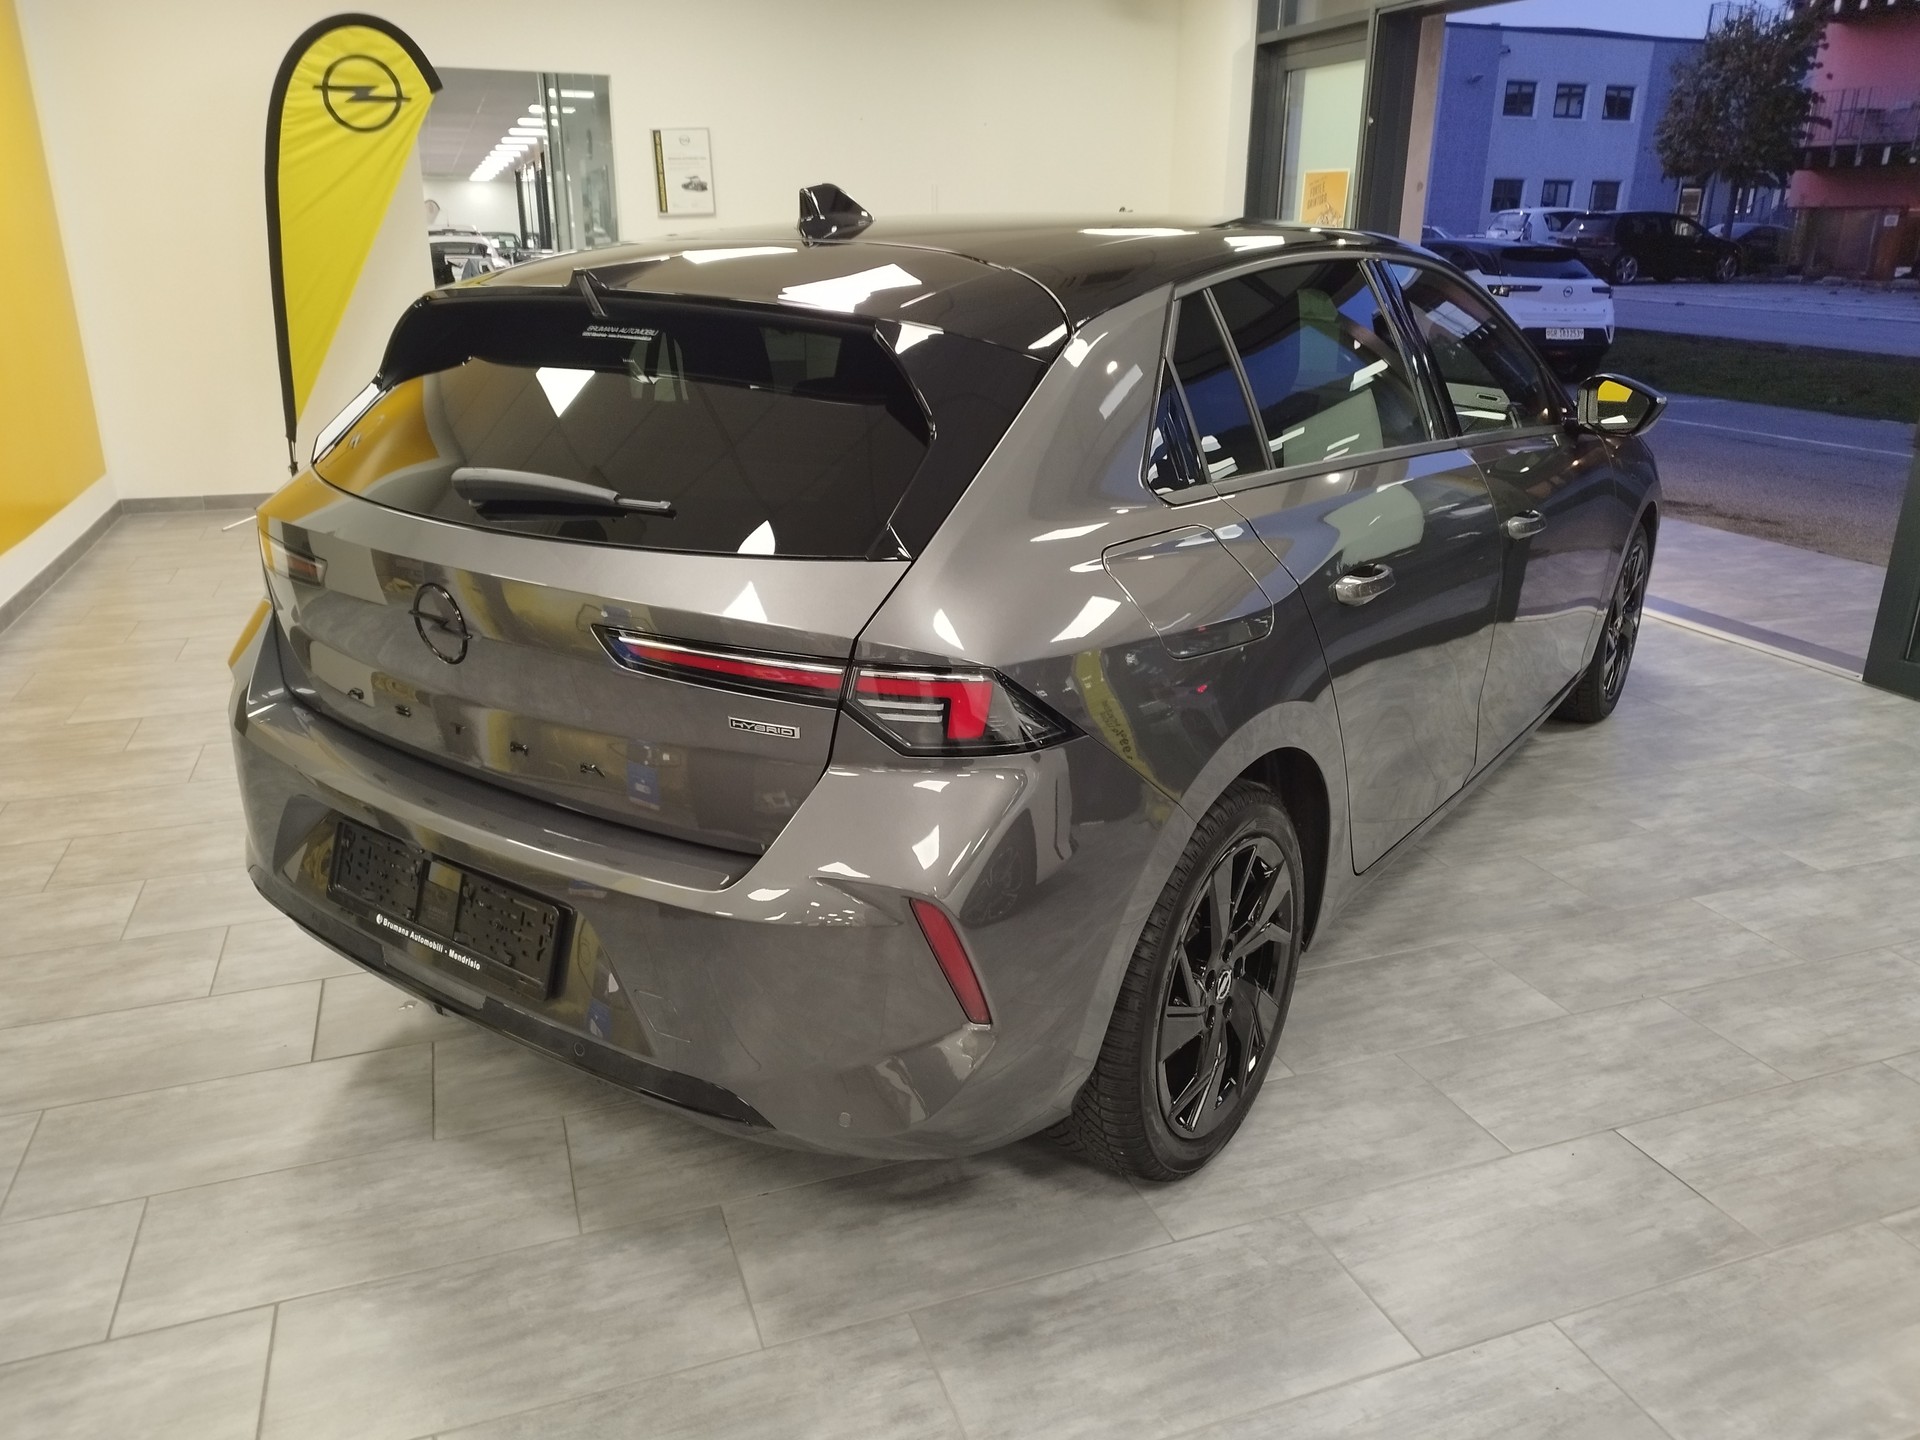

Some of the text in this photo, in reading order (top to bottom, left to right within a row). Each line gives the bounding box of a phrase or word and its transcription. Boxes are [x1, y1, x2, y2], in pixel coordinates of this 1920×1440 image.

[732, 720, 794, 736] HYBRID
[382, 917, 409, 937] Brumana
[409, 930, 444, 953] Automobili
[448, 948, 481, 971] Mendrisio
